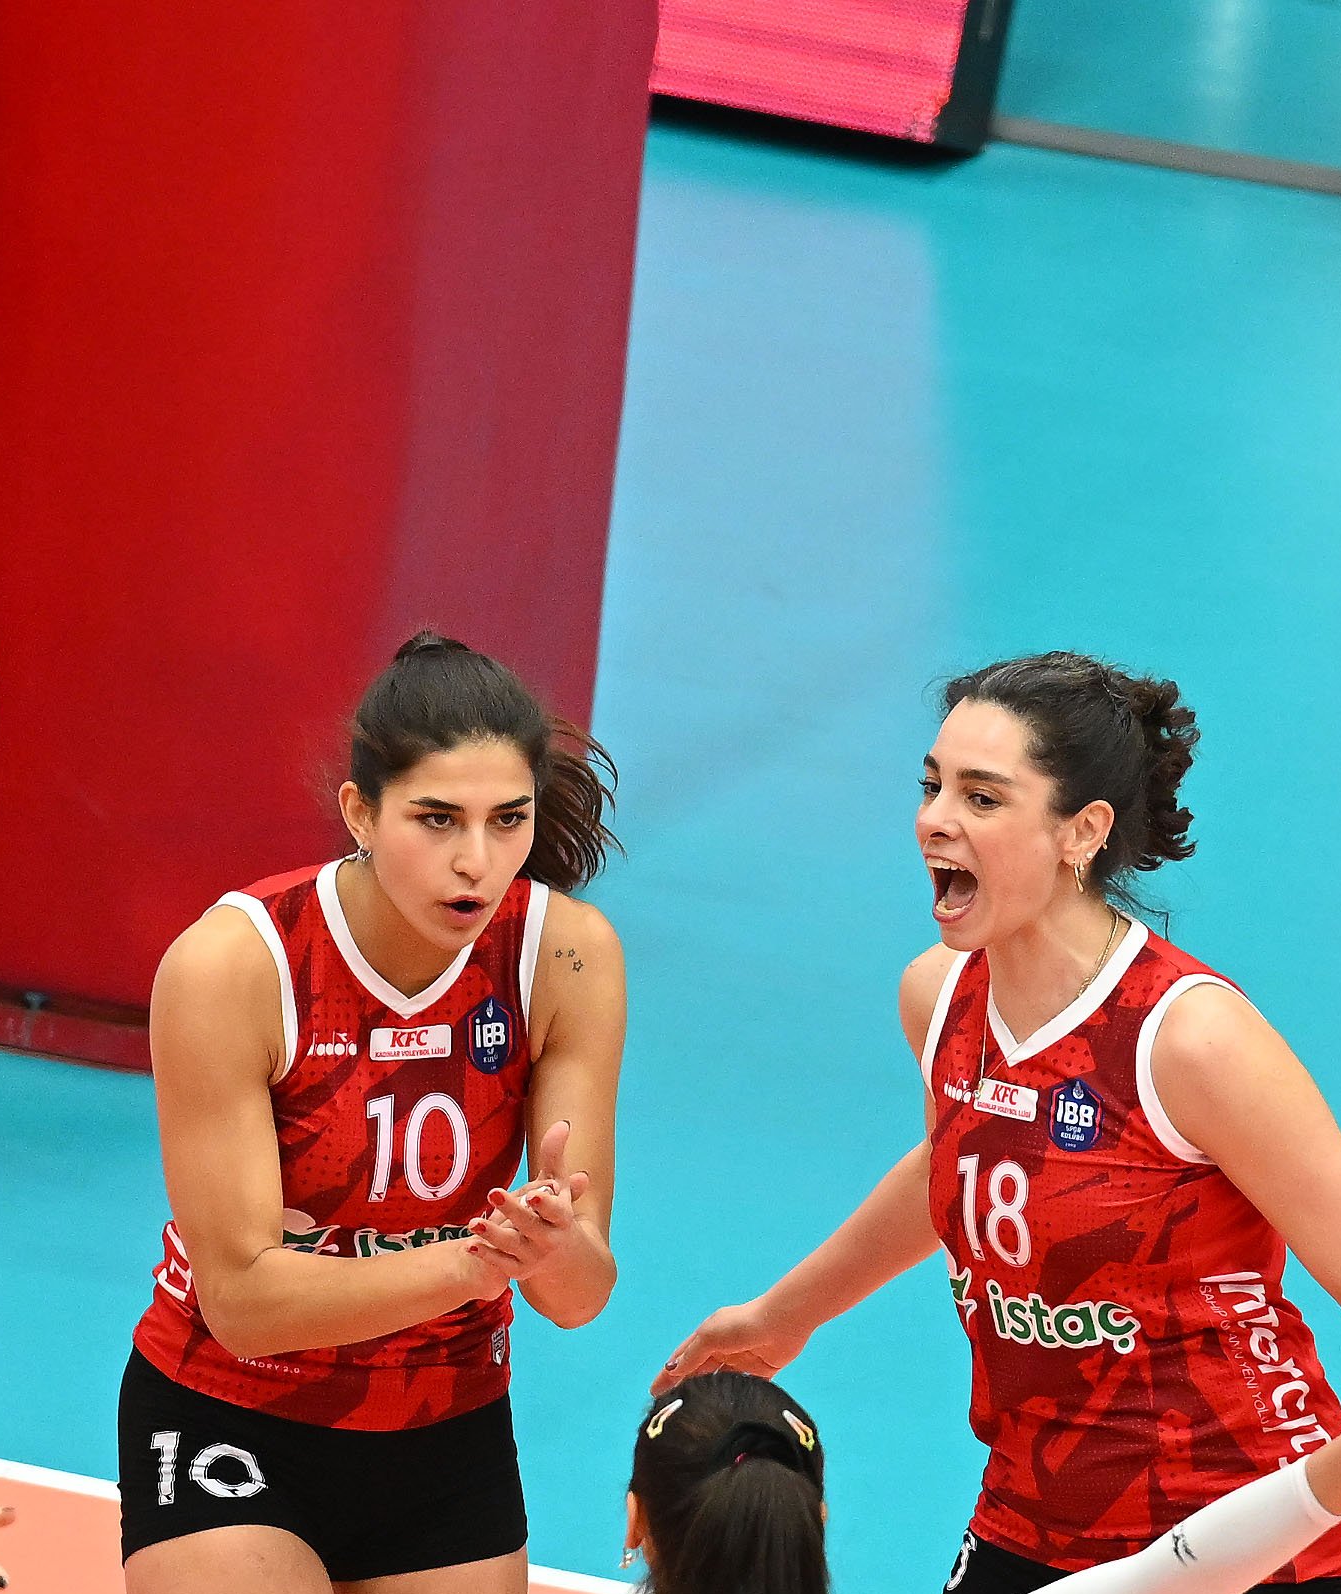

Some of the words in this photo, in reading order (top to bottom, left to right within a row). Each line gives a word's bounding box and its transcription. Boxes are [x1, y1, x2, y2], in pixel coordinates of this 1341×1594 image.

[390, 1029, 429, 1049] KFC
[990, 1083, 1019, 1106] KFC
[365, 1092, 471, 1203] 10
[956, 1153, 1032, 1268] 18
[987, 1278, 1139, 1354] istaç
[1200, 1271, 1333, 1469] Intercit
[1251, 1391, 1269, 1425] YOLU
[149, 1430, 270, 1505] 10
